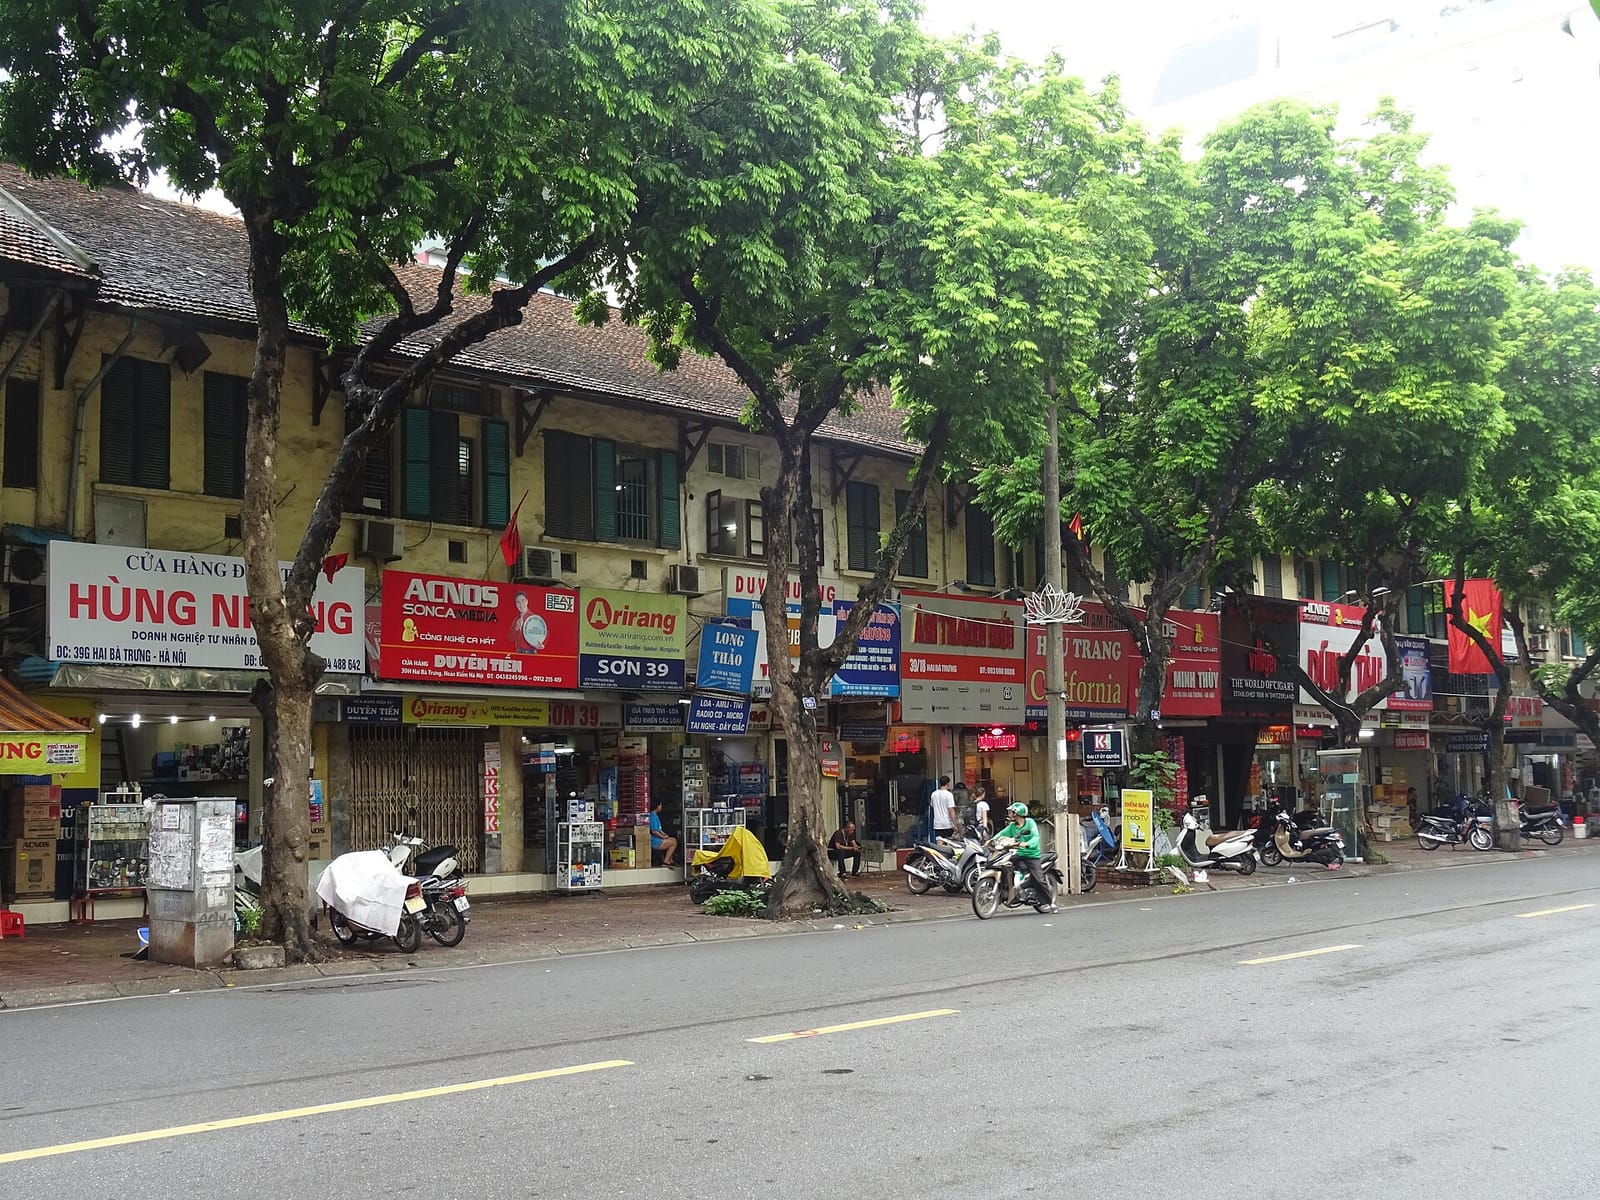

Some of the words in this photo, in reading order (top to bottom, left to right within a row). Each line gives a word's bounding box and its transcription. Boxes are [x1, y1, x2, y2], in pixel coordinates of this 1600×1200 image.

[126, 551, 167, 573] CỬA
[172, 556, 227, 578] HÀNG
[69, 575, 197, 626] HÙNG
[403, 577, 499, 608] ACNOS
[546, 594, 574, 604] BEAT
[586, 597, 677, 635] Arirang
[131, 631, 167, 642] DOANH
[170, 633, 206, 646] NGHIỆP
[419, 632, 443, 642] CÔNG
[466, 636, 478, 644] CA
[714, 631, 745, 647] LONG
[92, 647, 107, 661] HAI
[109, 646, 121, 661] BÀ
[159, 648, 169, 664] HÀ
[172, 650, 187, 667] NỘI
[712, 649, 743, 667] THẢO
[1073, 638, 1121, 661] TRANG
[348, 660, 361, 672] 642
[434, 653, 488, 671] DUYÊN
[490, 653, 523, 673] TIẾN
[597, 659, 641, 676] SƠN
[645, 662, 669, 677] 39
[1173, 671, 1195, 689] MINH
[1231, 678, 1243, 688] THE
[1244, 680, 1264, 689] WORLD
[411, 699, 467, 718] Arirang
[579, 704, 598, 726] 39
[701, 722, 715, 730] NGHE
[485, 779, 500, 794] K+
[485, 798, 500, 812] K+
[485, 816, 500, 831] K+
